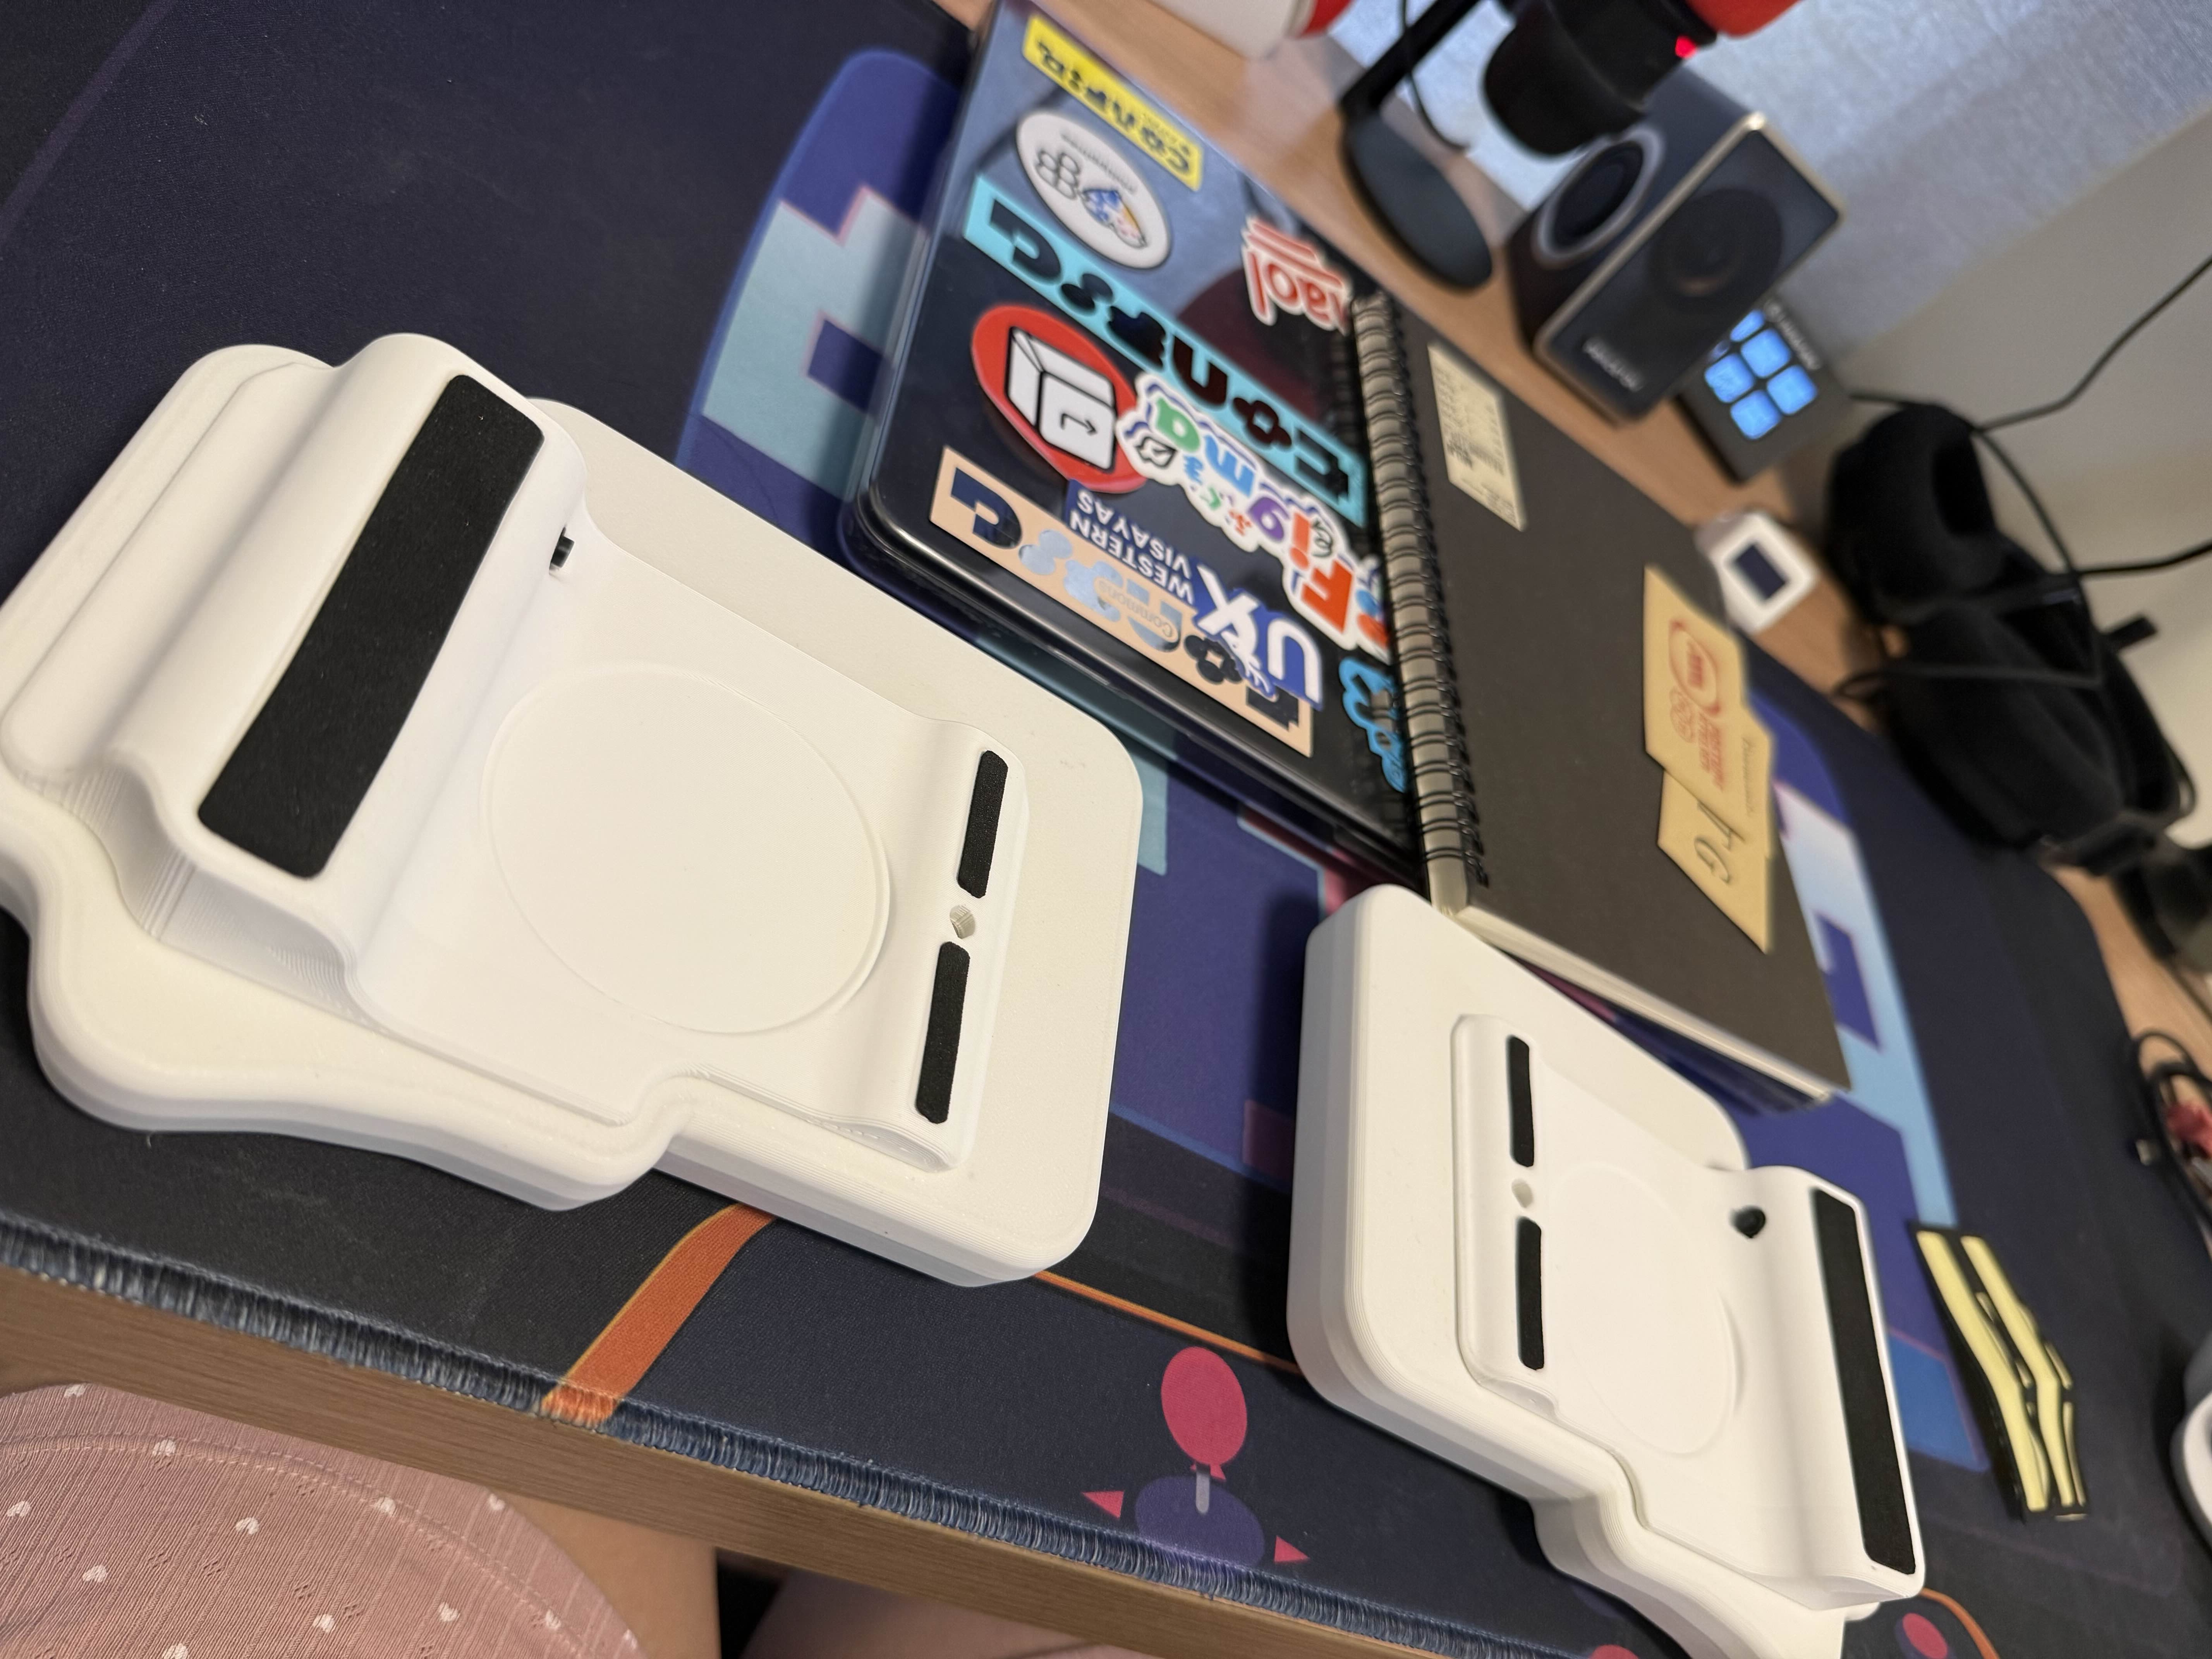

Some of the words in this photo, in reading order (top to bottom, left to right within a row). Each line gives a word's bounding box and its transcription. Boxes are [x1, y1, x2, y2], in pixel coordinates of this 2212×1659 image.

[1069, 509, 1194, 605] WESTERN
[1077, 490, 1192, 580] VISAYAS
[1154, 398, 1353, 633] Figma
[1098, 580, 1173, 638] Commons
[1197, 564, 1321, 702] UX
